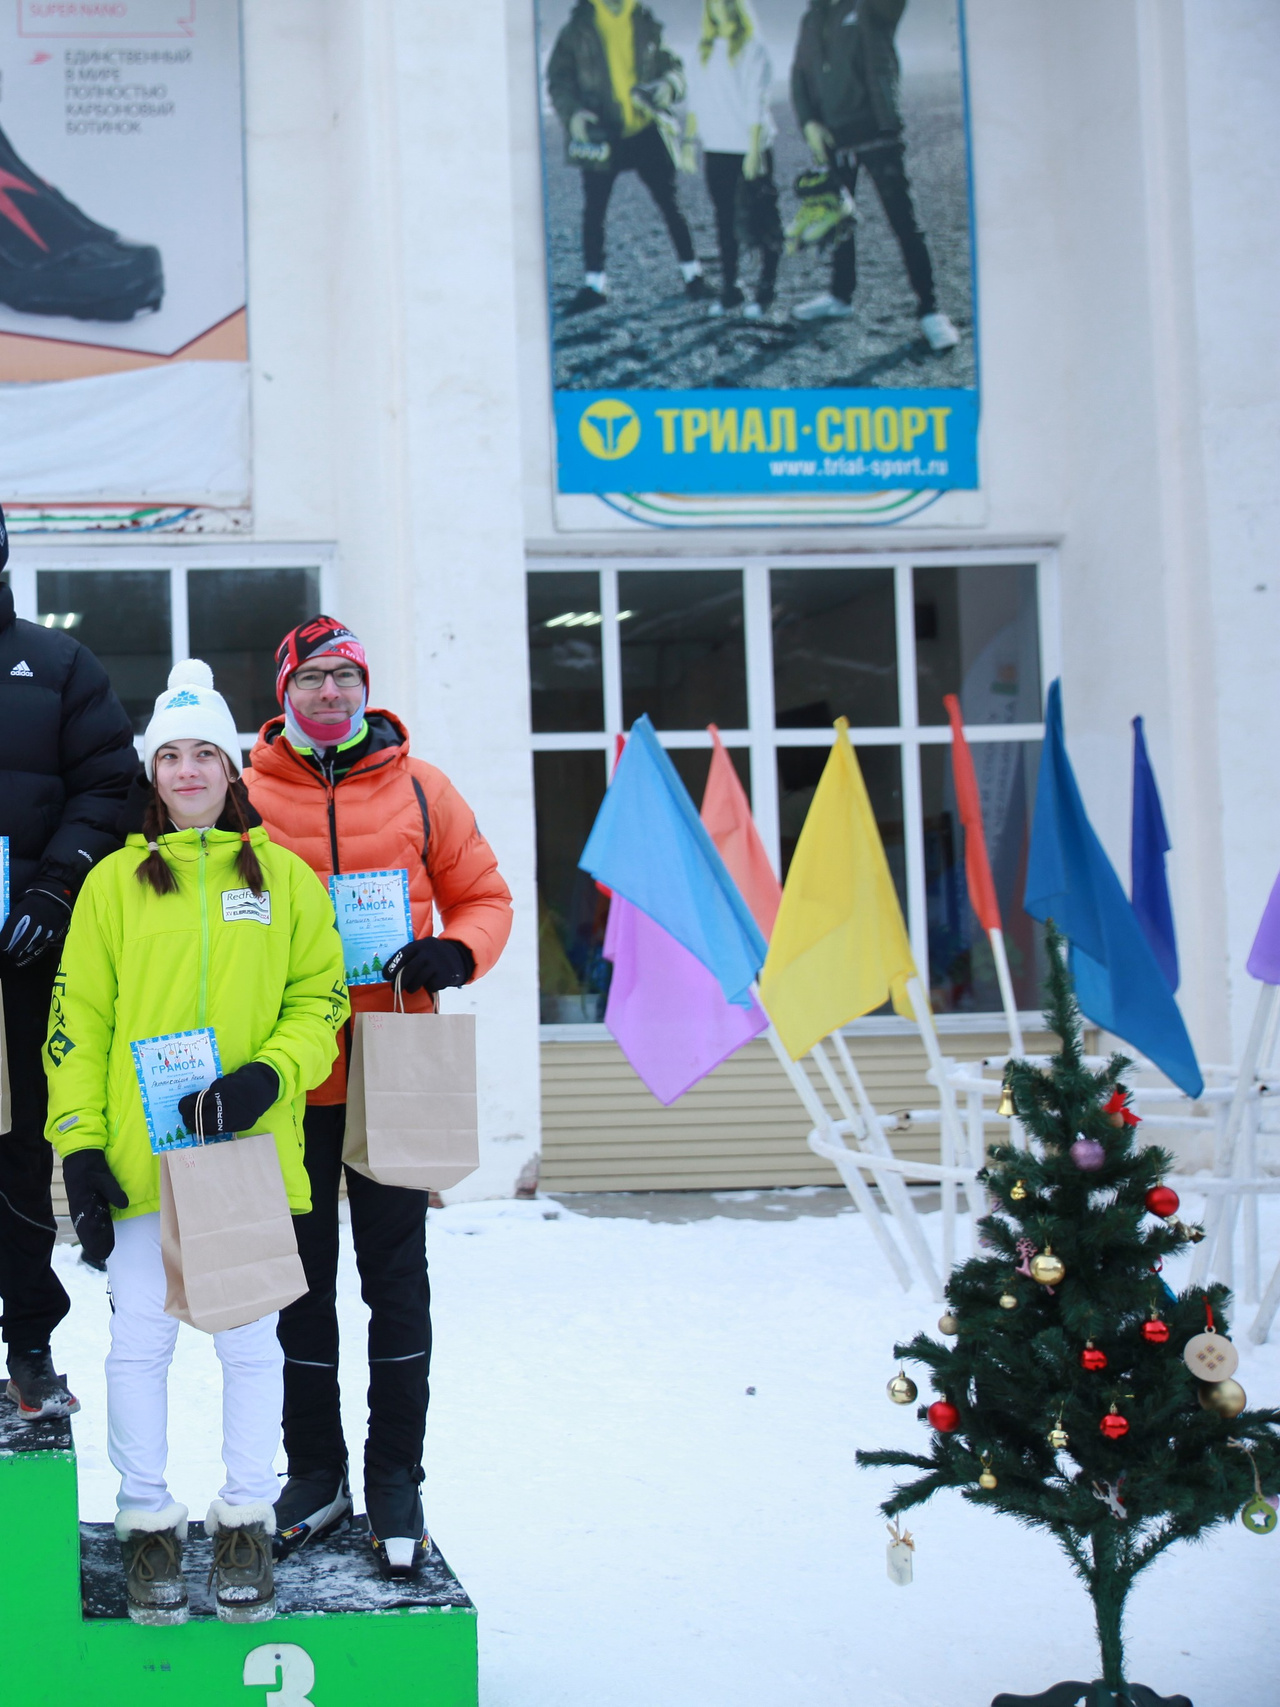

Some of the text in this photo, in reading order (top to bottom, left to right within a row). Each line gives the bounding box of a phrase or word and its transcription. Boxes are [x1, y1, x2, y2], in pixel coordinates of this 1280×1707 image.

[769, 456, 948, 478] www.trial-sport.ru
[227, 890, 257, 901] RedFo
[344, 900, 395, 913] ГРАМОТА
[151, 1058, 205, 1075] ГРАМОТА
[214, 1092, 223, 1131] NORDSKI
